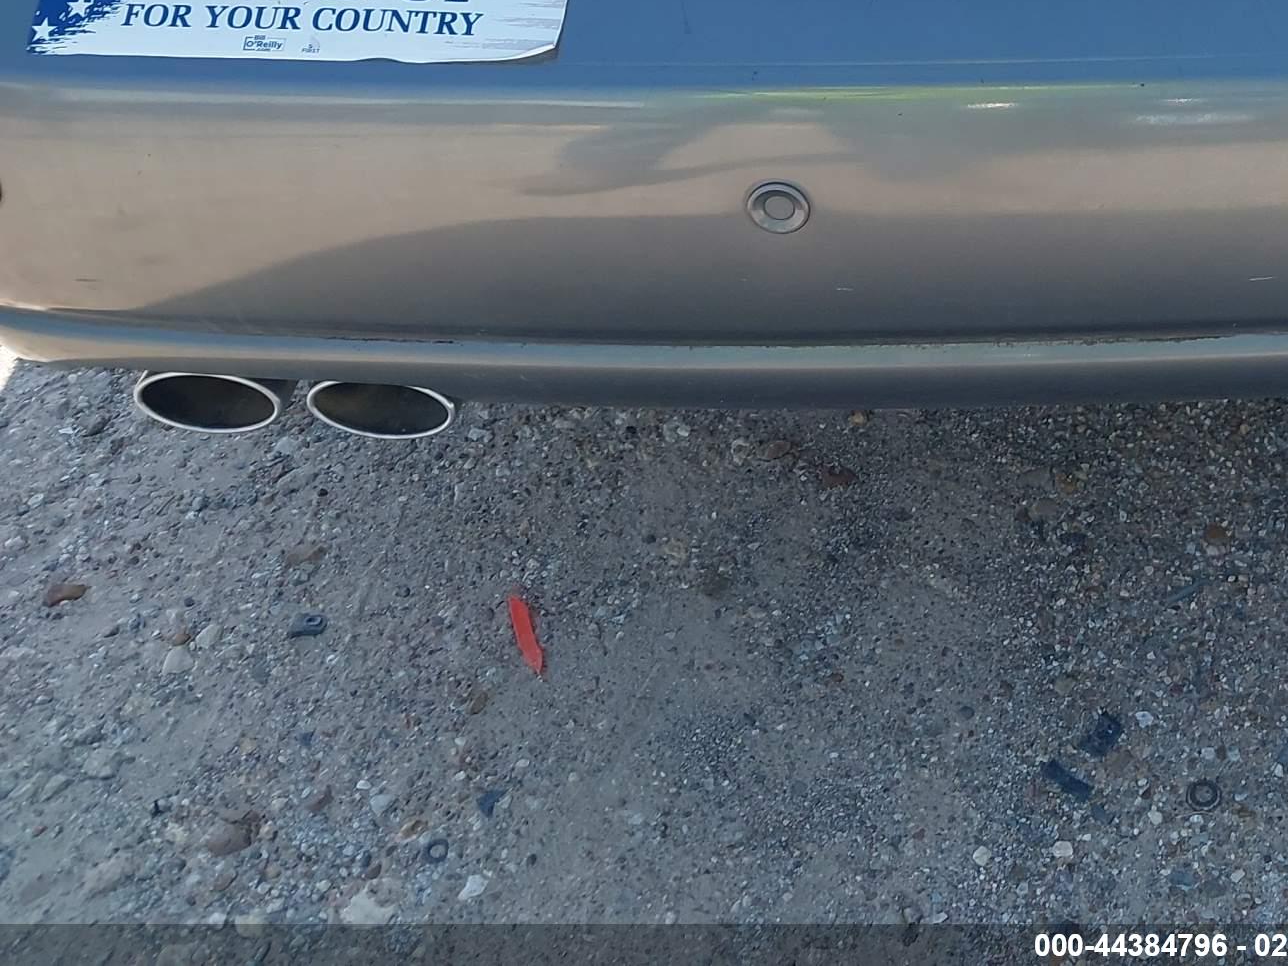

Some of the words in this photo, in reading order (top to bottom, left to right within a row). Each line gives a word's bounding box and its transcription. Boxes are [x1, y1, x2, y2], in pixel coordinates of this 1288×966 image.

[121, 3, 193, 28] FOR
[205, 5, 301, 31] YOUR
[312, 7, 484, 36] COUNTRY
[246, 40, 283, 49] O'Reilly
